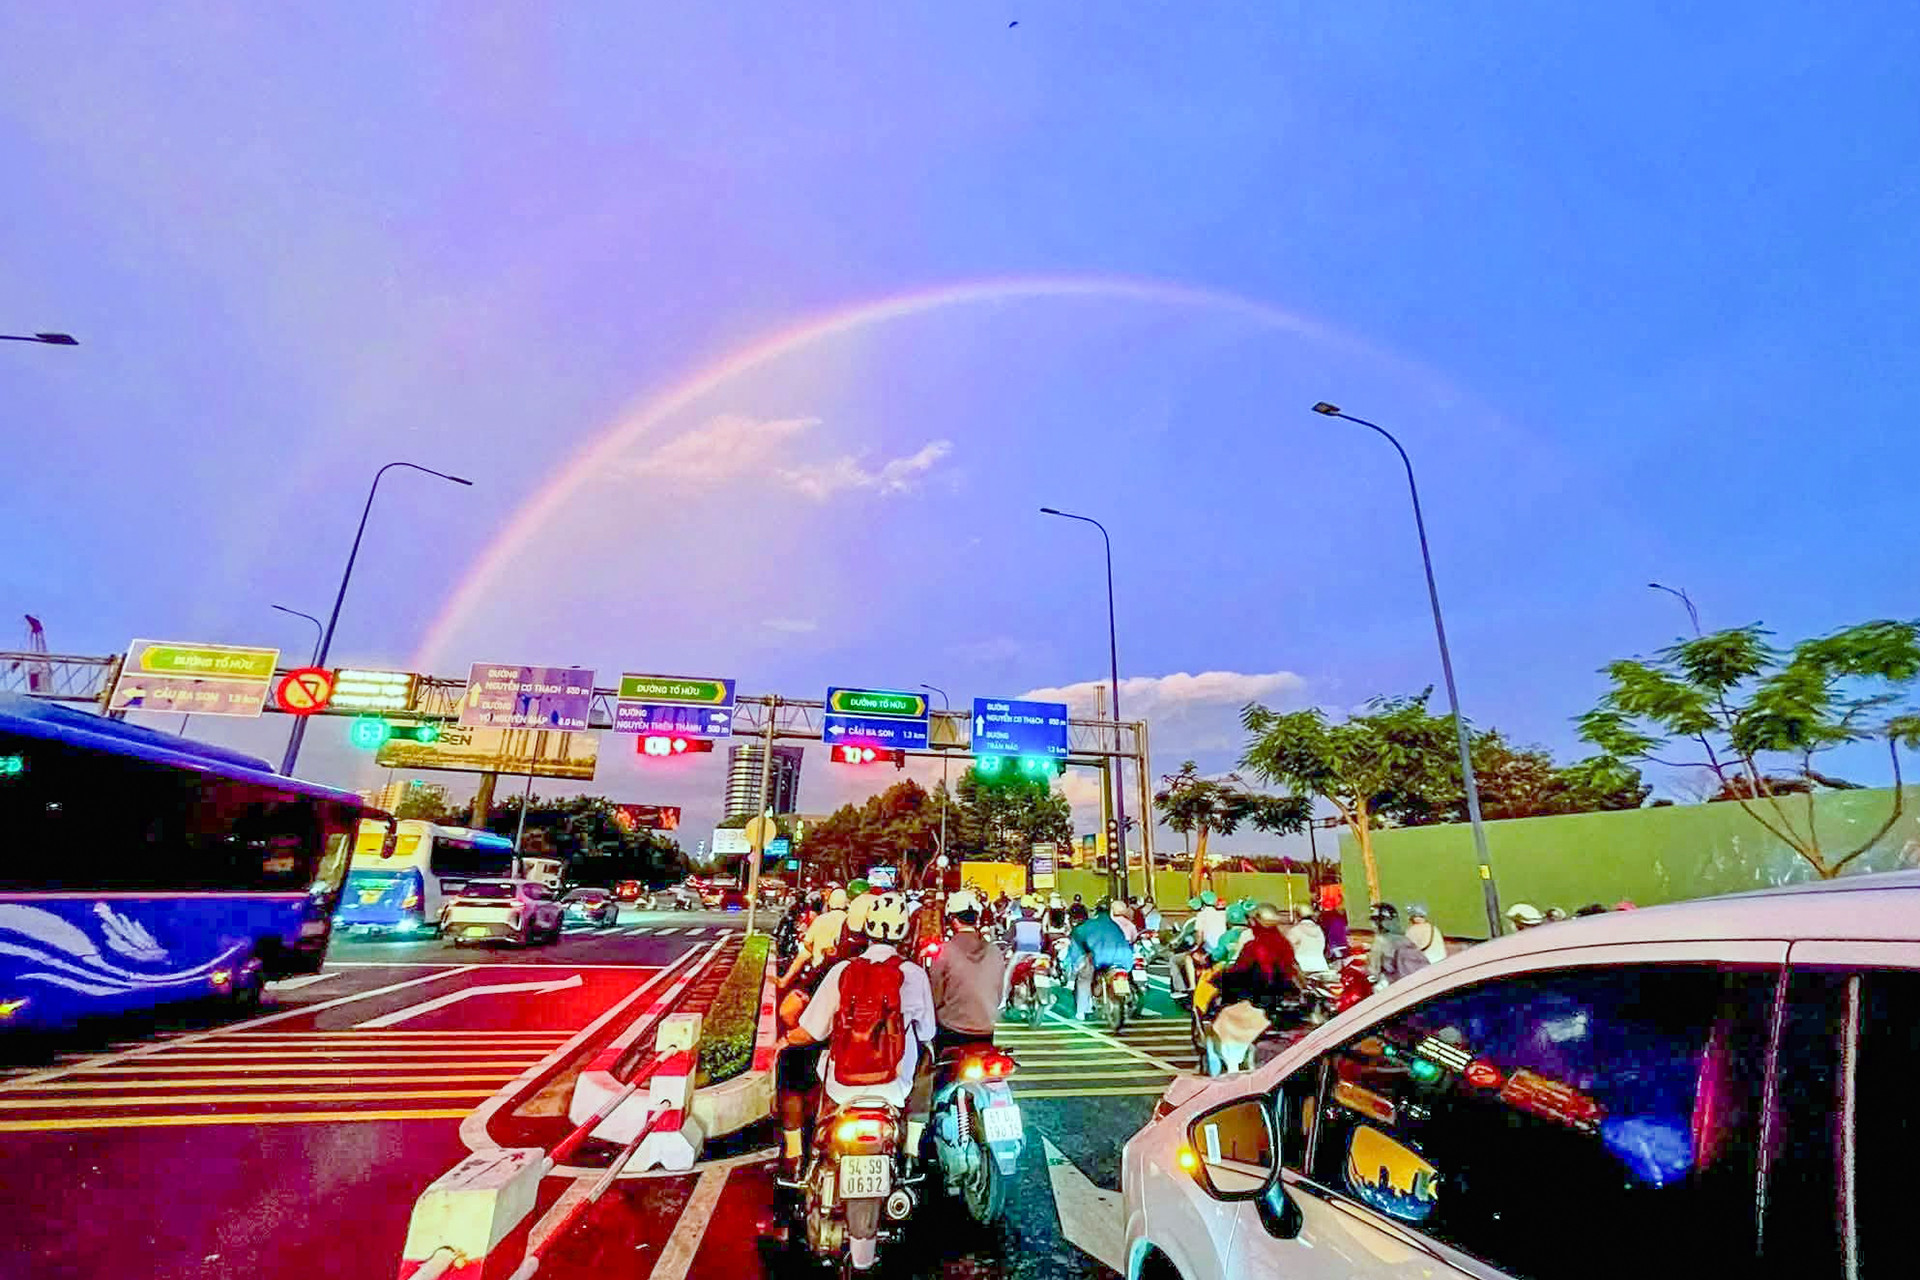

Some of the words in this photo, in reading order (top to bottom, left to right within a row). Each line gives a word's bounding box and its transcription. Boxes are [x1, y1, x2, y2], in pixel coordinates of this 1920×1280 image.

[637, 684, 667, 694] ĐƯỜNG
[669, 685, 680, 694] TỐ
[681, 686, 700, 696] HỮU
[850, 698, 877, 708] ĐƯỜNG
[880, 699, 889, 708] TỐ
[890, 701, 906, 709] HỮU
[619, 708, 647, 717] ĐƯỜNG
[848, 725, 864, 736] CẦU
[865, 728, 877, 736] BA
[913, 731, 926, 739] km
[847, 1177, 883, 1193] 0632
